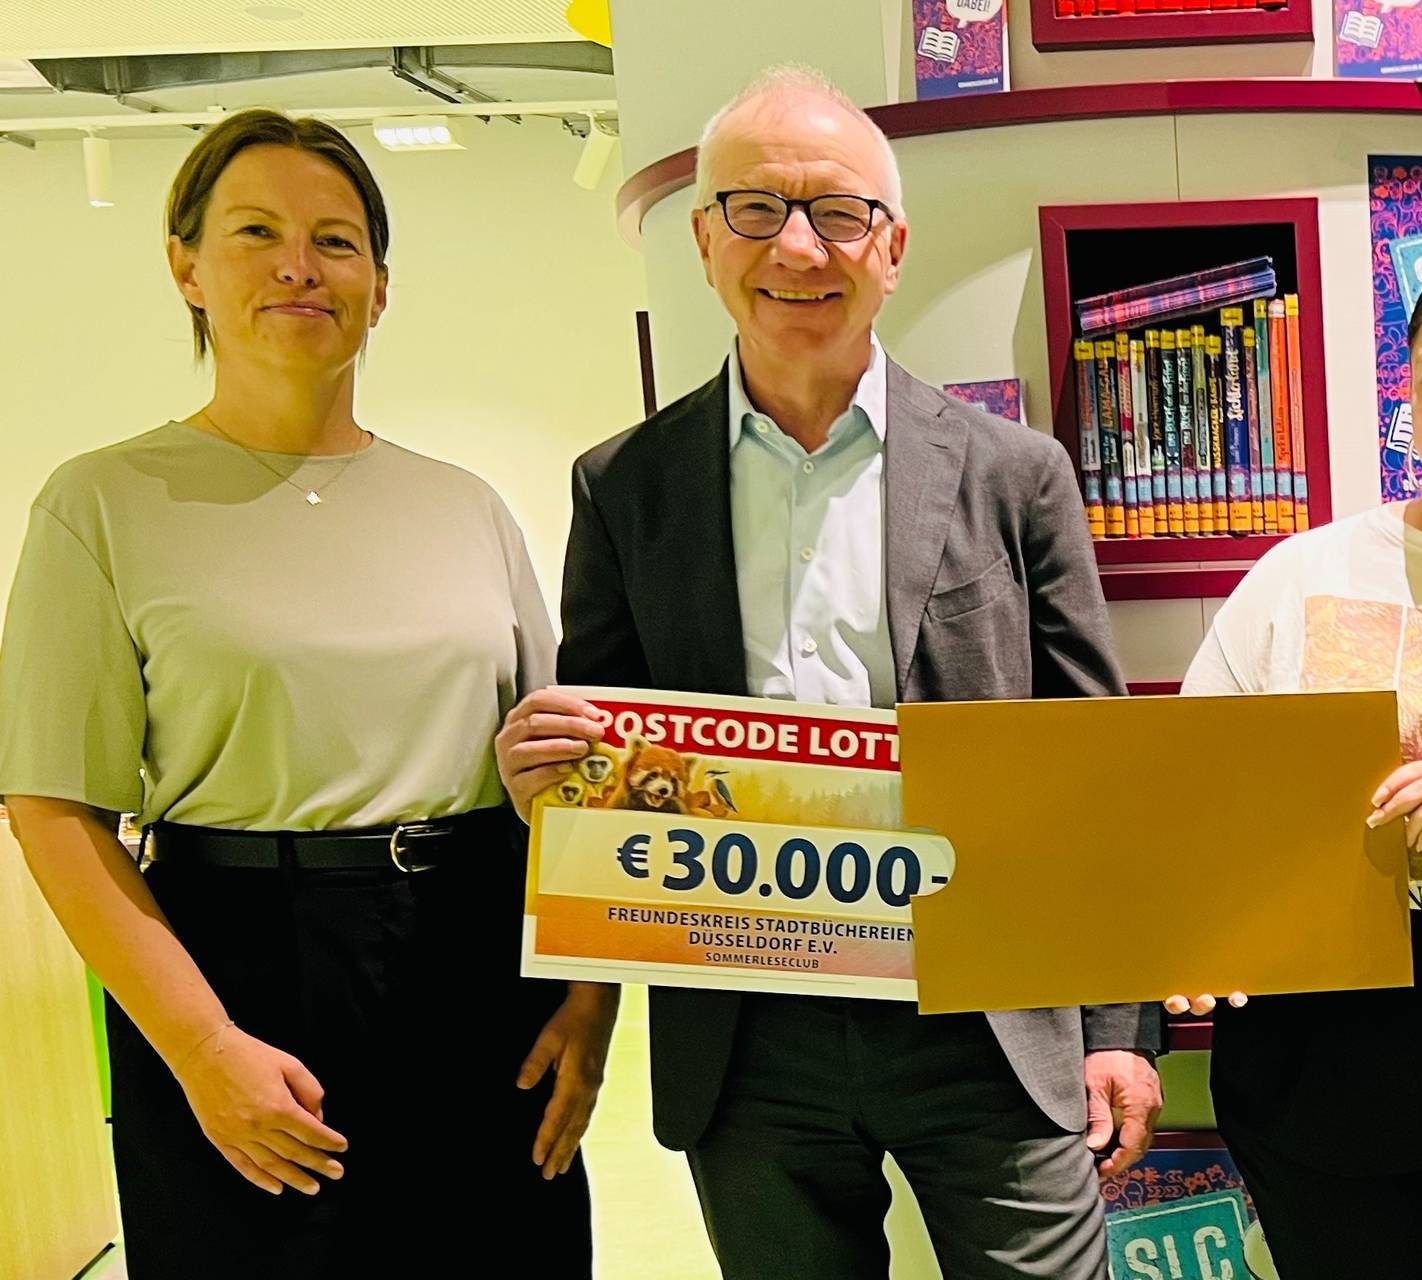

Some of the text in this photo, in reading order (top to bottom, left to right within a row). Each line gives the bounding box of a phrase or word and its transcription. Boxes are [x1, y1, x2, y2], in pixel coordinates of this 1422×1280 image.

[809, 727, 900, 763] LOTT
[616, 833, 651, 878] €
[608, 907, 915, 941] FREUNDESKREIS STADTBÜCHEREIEN
[689, 928, 838, 954] DÜSSELDORF E.V.
[705, 952, 820, 969] SOMMERLESECLUB
